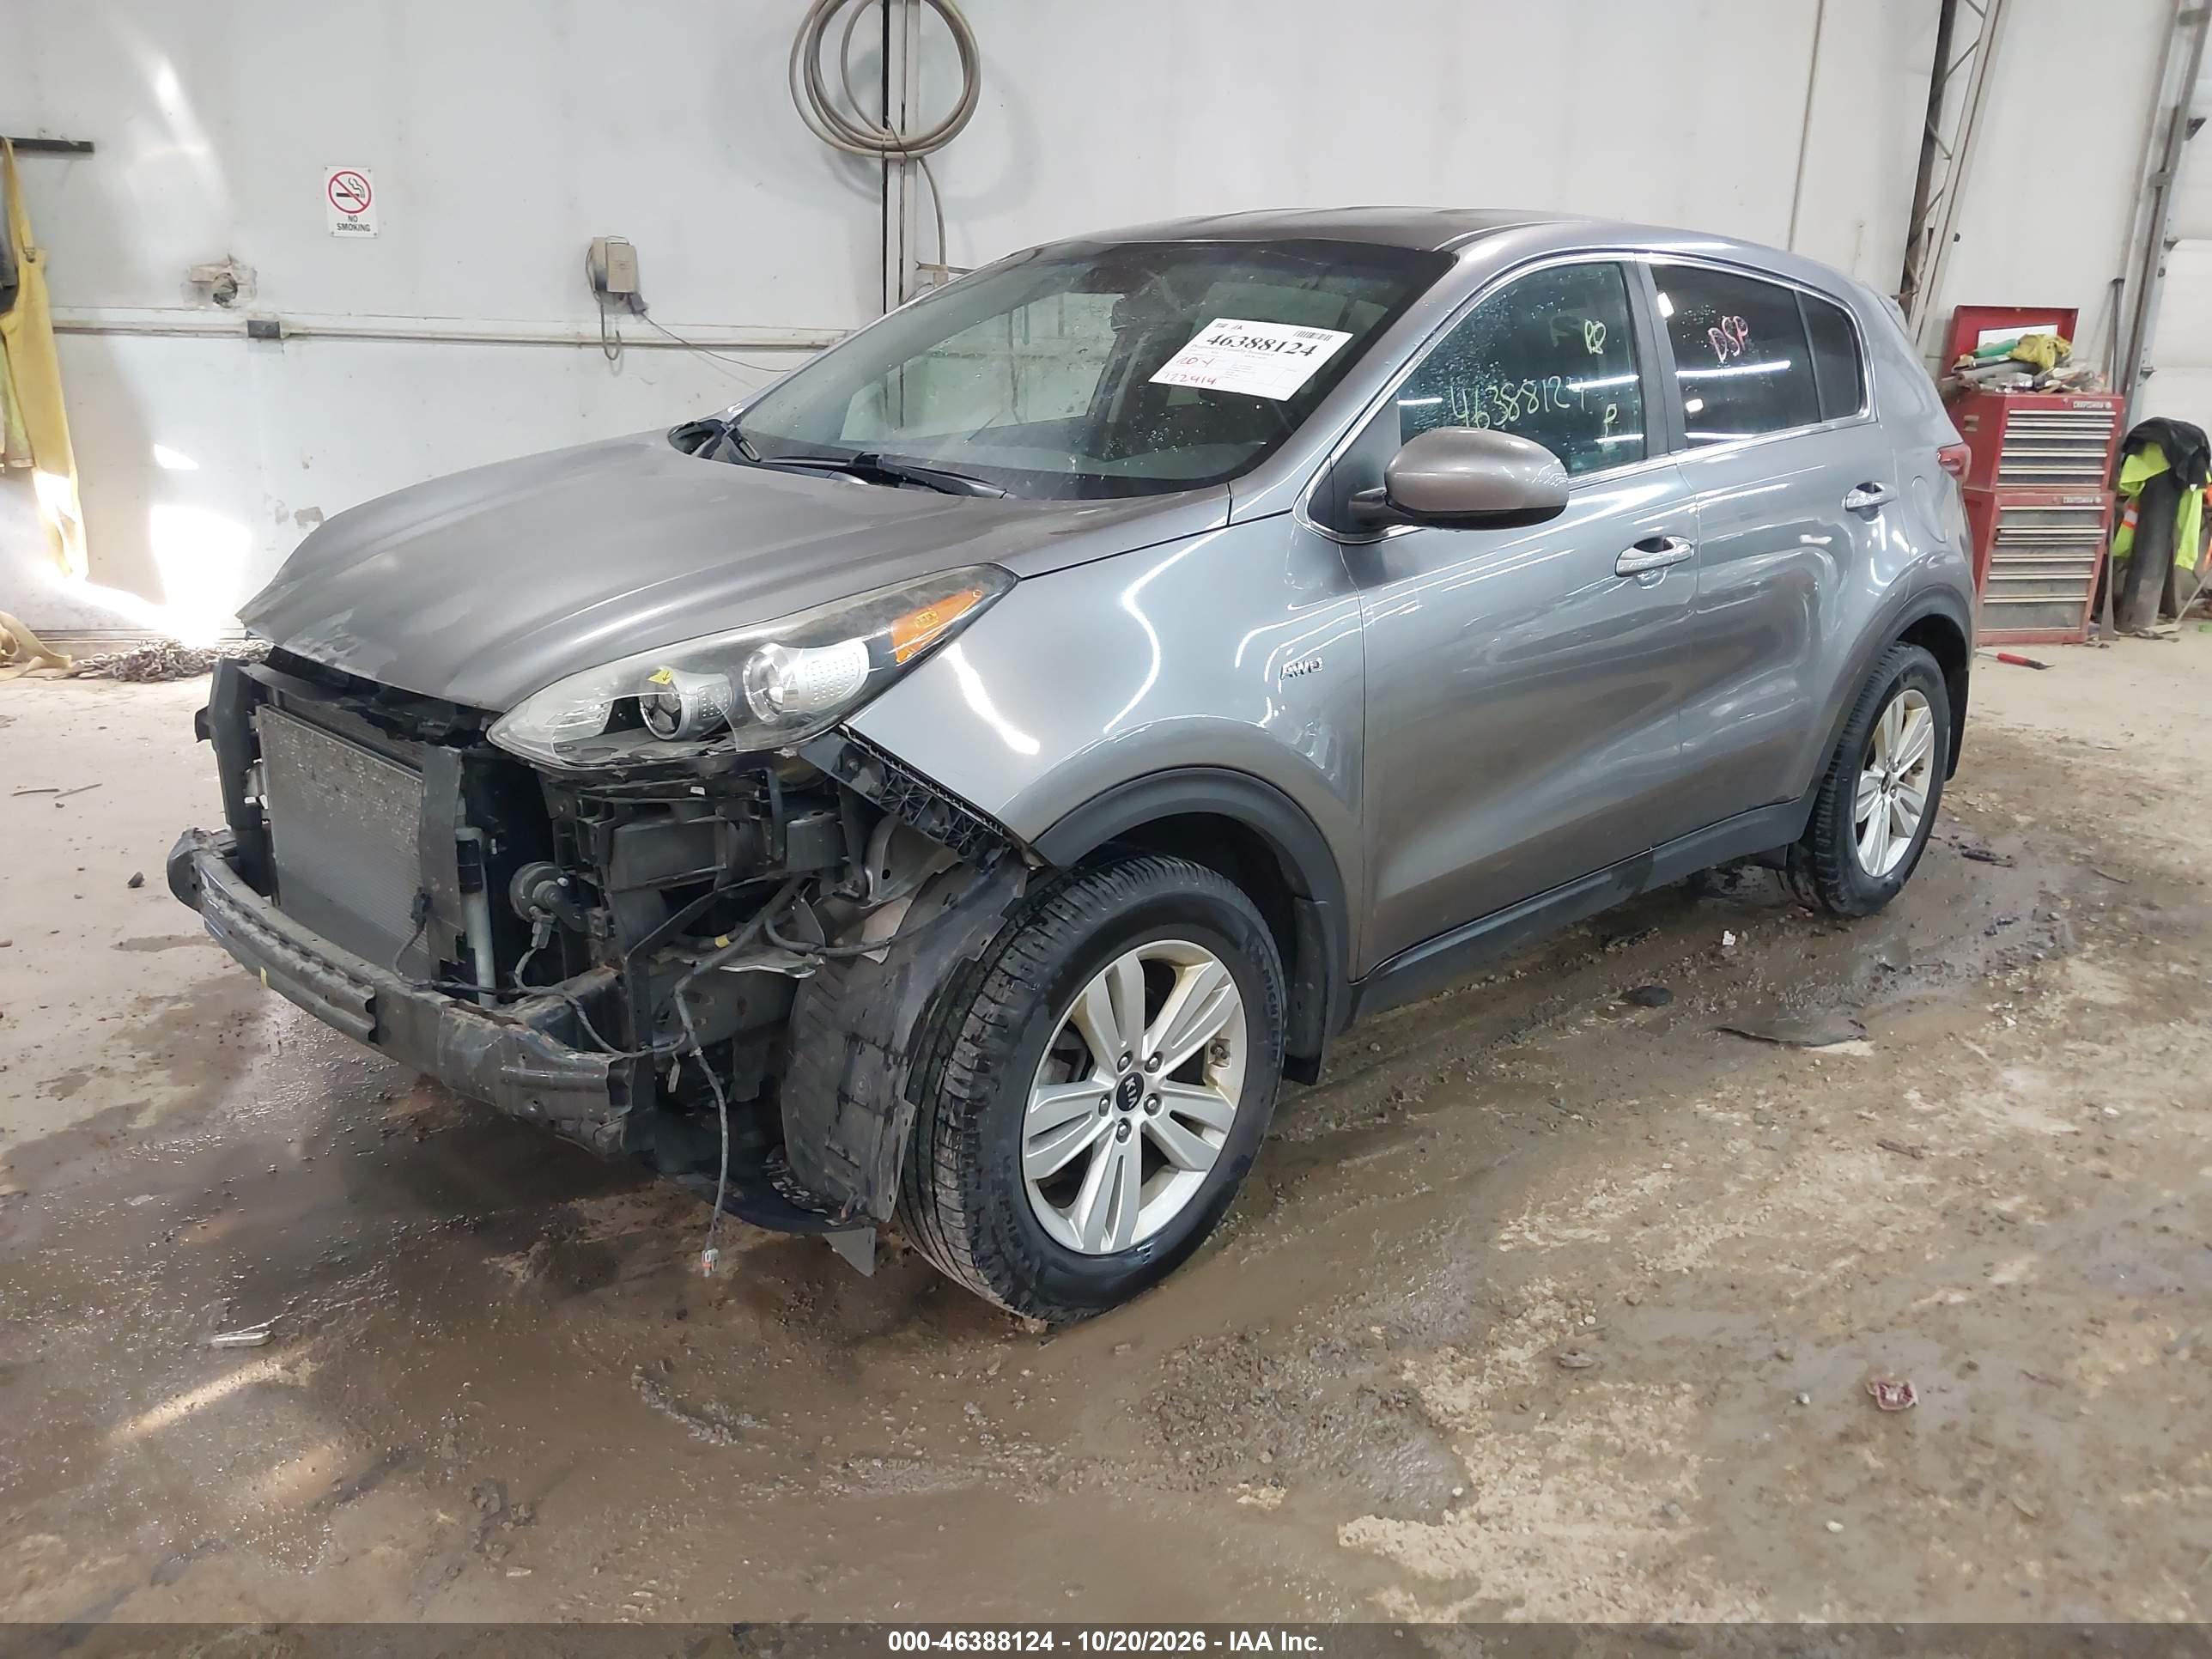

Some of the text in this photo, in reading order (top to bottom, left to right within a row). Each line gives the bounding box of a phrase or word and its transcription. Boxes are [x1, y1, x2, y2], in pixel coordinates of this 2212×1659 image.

[337, 223, 371, 232] SMOKING
[348, 215, 358, 223] NO
[1206, 333, 1318, 357] 46388124
[1450, 375, 1586, 429] 46388124
[1279, 659, 1322, 681] AWD
